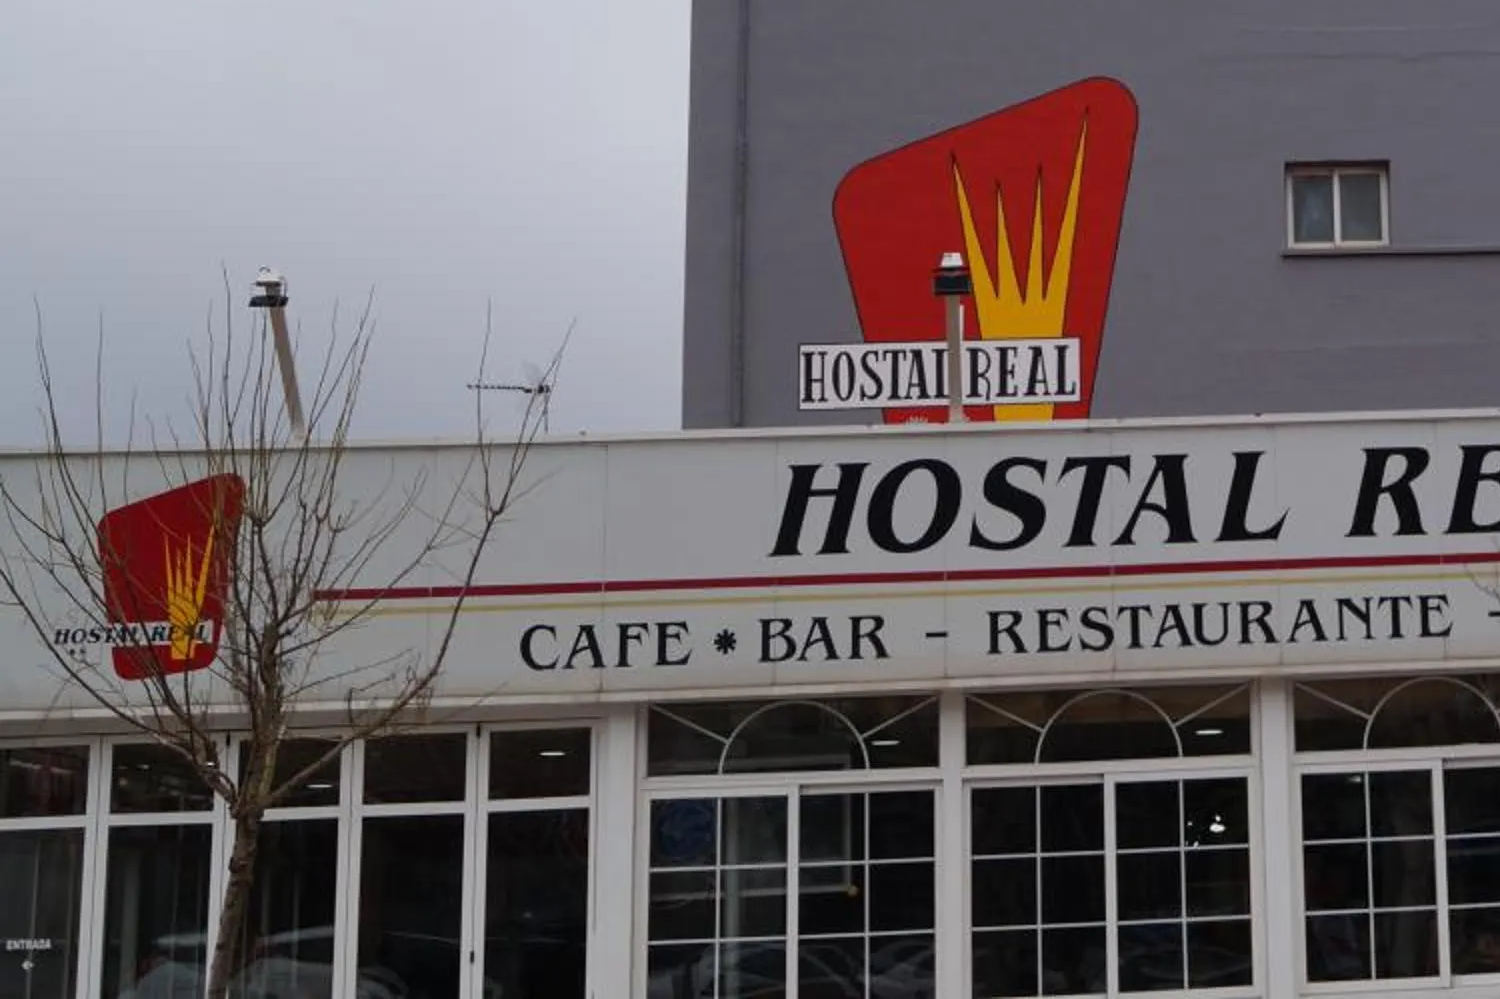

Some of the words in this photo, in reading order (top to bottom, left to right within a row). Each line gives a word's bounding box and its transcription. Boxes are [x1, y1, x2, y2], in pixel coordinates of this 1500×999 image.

[965, 344, 1077, 401] REAL
[767, 451, 1291, 559] HOSTAL
[518, 620, 692, 671] CAFE
[757, 615, 891, 663] BAR
[986, 593, 1454, 656] RESTAURANTE
[6, 938, 52, 950] ENTRADA
